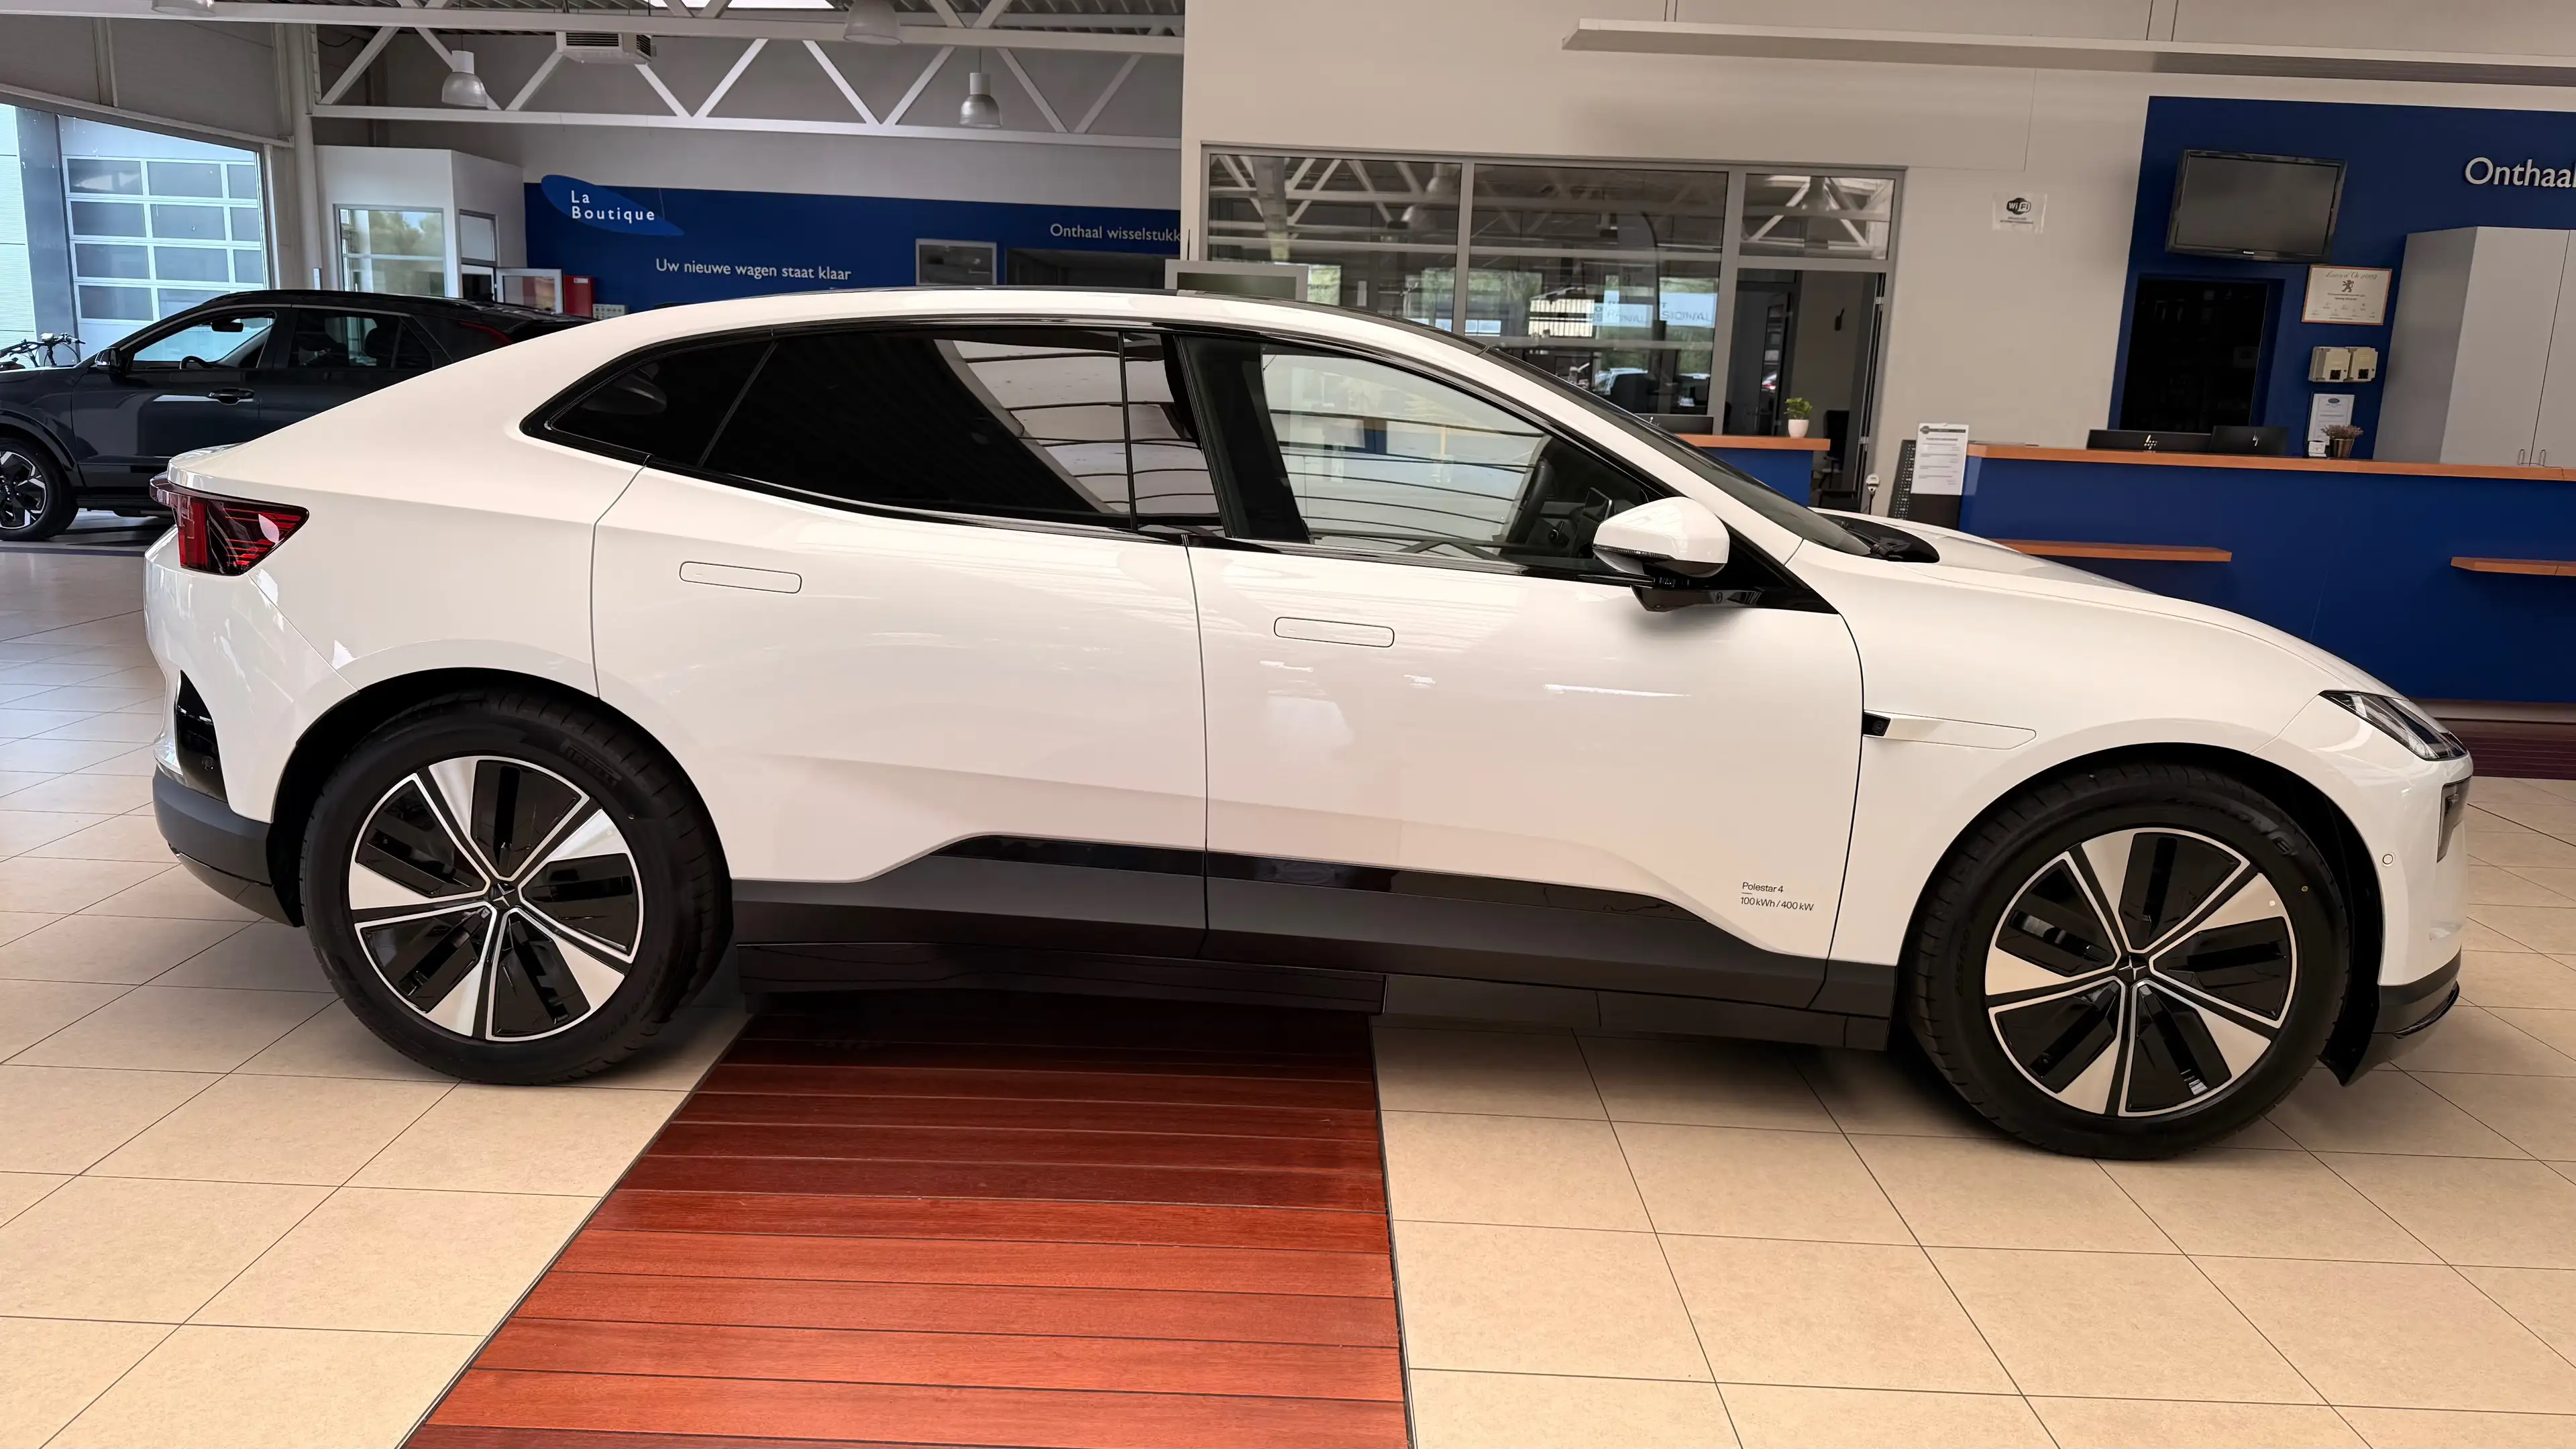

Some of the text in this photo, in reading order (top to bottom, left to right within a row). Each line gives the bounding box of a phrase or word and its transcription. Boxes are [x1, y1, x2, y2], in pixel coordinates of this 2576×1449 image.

[2464, 156, 2576, 189] Onthaal
[571, 190, 590, 204] La
[572, 205, 655, 225] Boutique
[1050, 223, 1180, 241] Onthaal wisselstukk
[656, 258, 851, 281] Uw nieuwe wagen staat klaar
[1742, 881, 1777, 893] Polestar
[1741, 897, 1756, 906] 100
[1756, 899, 1775, 908] kWh
[1781, 901, 1798, 910] 400
[1799, 903, 1814, 911] kW
